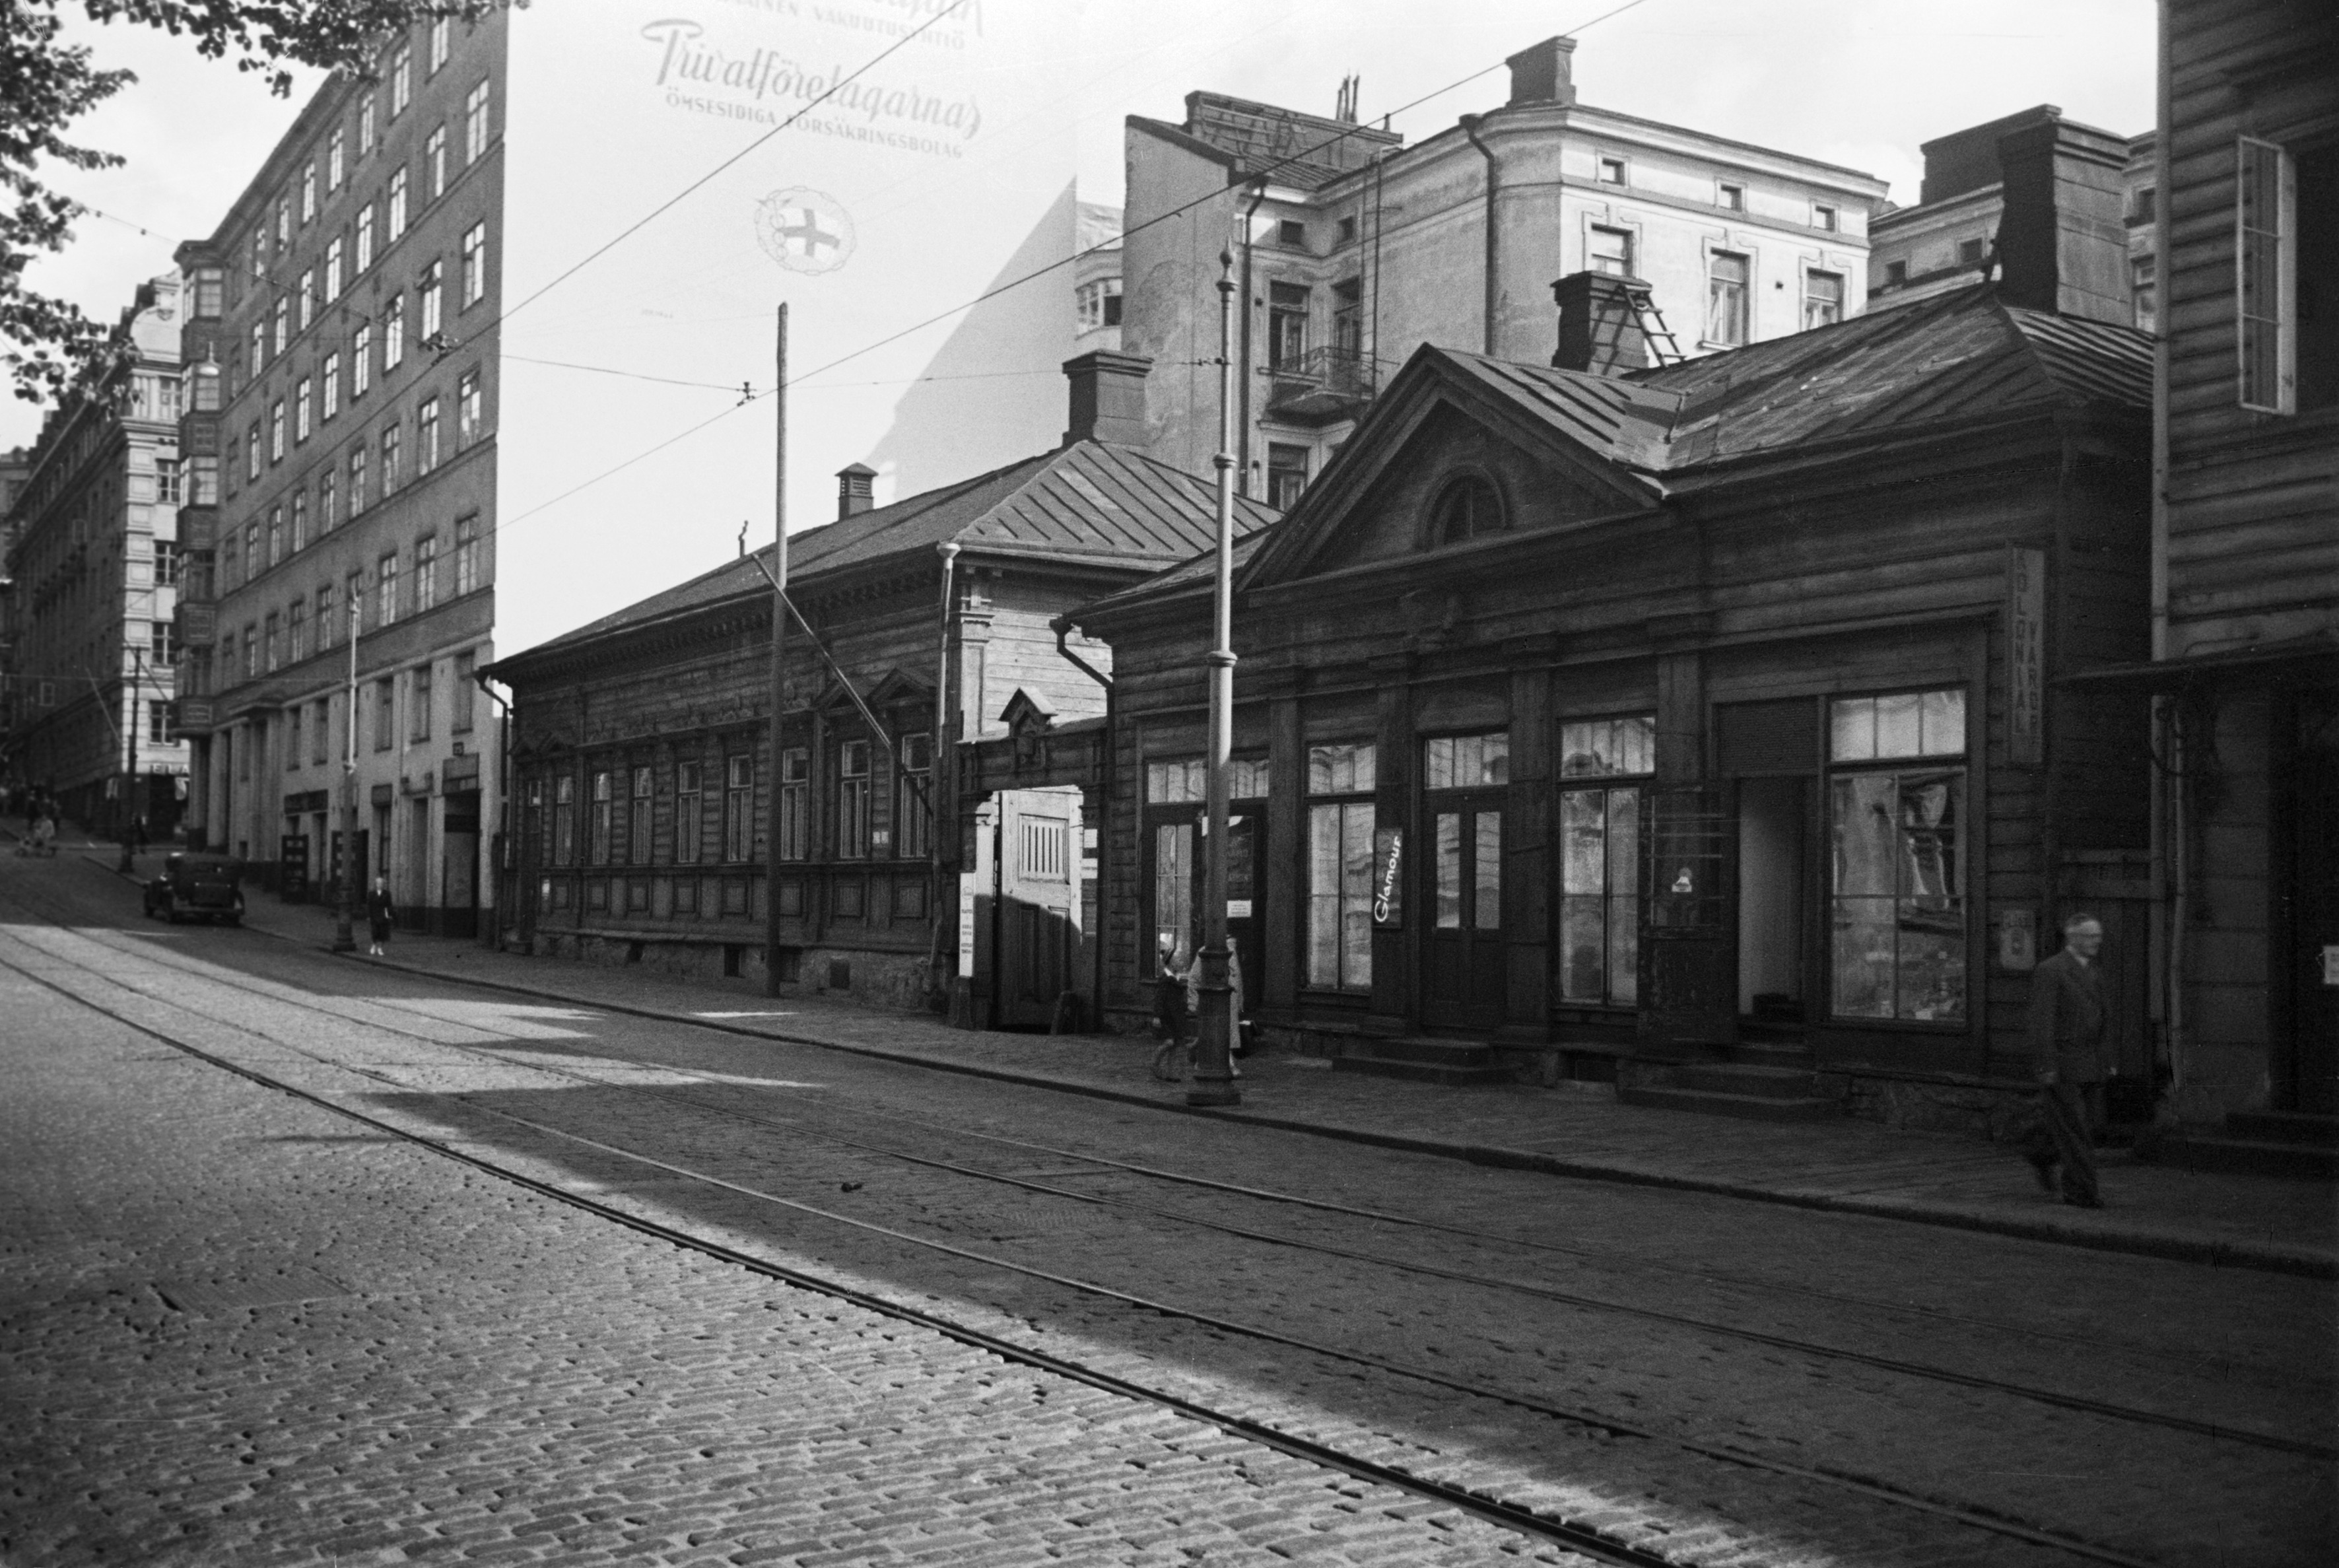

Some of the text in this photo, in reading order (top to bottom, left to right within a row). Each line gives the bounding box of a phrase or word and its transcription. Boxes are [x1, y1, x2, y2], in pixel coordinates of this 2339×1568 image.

[665, 86, 776, 126] ÖMSESIDIGA
[2014, 549, 2028, 734] KOLONIAL
[1374, 835, 1402, 923] Glamour
